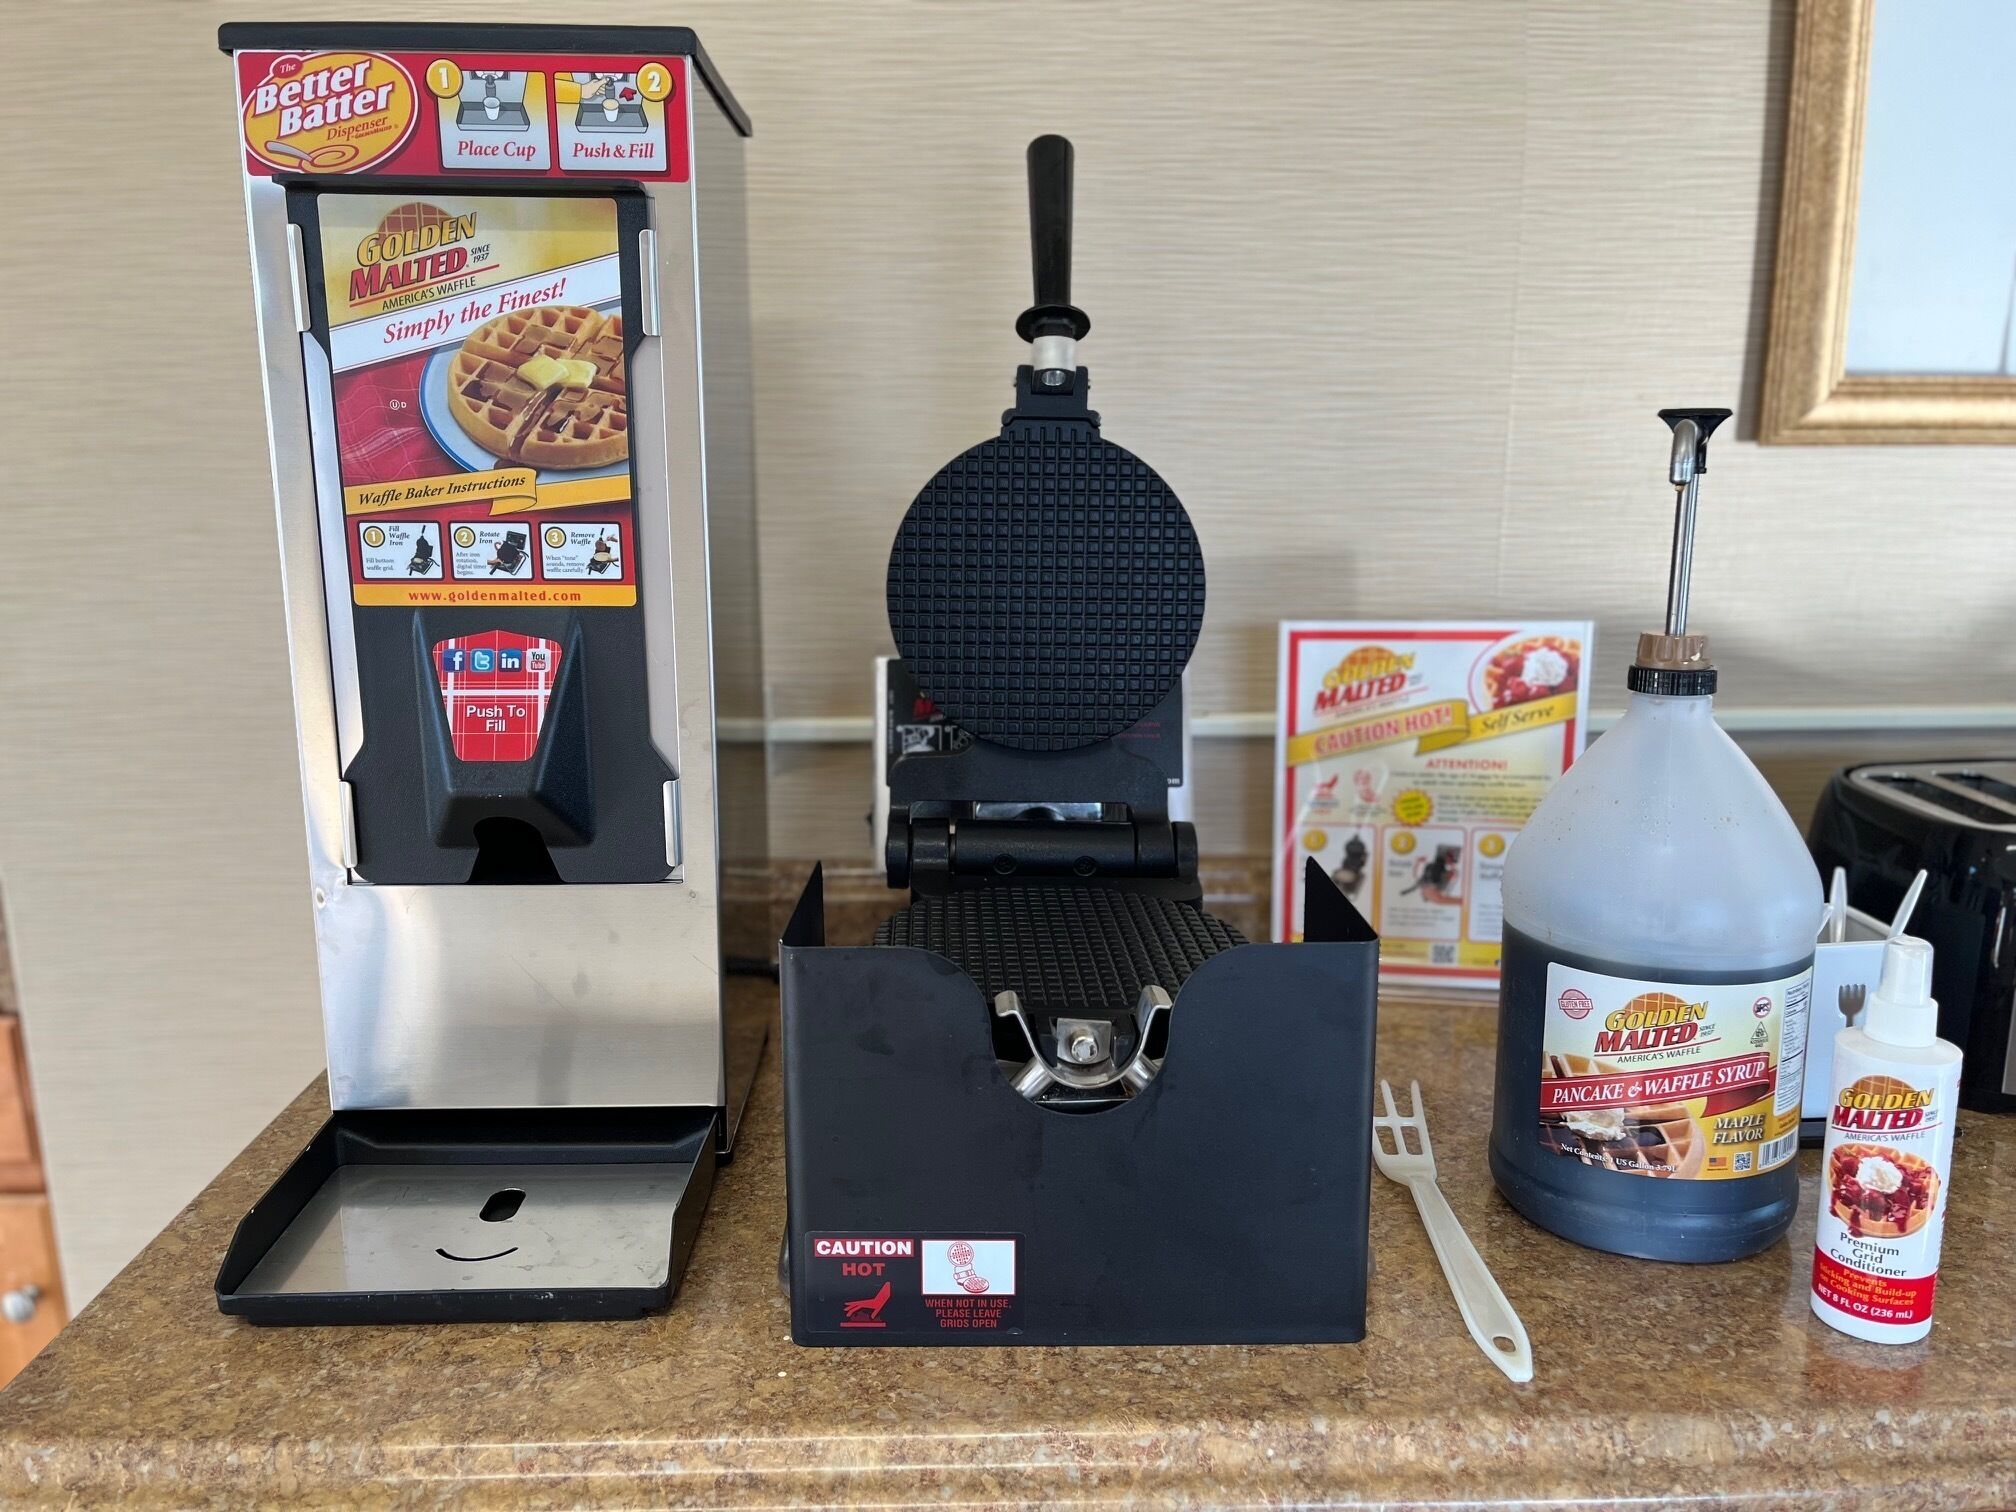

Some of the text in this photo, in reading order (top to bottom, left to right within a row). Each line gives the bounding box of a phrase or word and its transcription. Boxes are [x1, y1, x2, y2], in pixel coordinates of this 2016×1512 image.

[280, 63, 297, 74] The
[438, 67, 449, 88] 1
[255, 59, 371, 116] Better
[648, 71, 661, 92] 2
[278, 83, 393, 138] Batter
[326, 116, 388, 141] Dispenser
[457, 140, 536, 162] Place Cup
[573, 142, 655, 159] Push & Fill
[357, 212, 477, 267] GOLDEN
[470, 244, 491, 256] SINCE
[472, 253, 490, 264] 1937
[350, 246, 468, 301] MALTED
[382, 276, 476, 311] AMERICA'S WAFFLE
[383, 277, 567, 345] Simply the Finest!
[359, 476, 526, 506] Waffle Baker Instructions
[370, 530, 377, 542] 1
[460, 531, 468, 542] 2
[551, 532, 559, 543] 3
[408, 590, 581, 603] www.goldenmalted.com
[452, 651, 463, 670] f
[501, 653, 520, 669] in
[531, 651, 546, 661] You
[531, 660, 547, 670] Tube
[1313, 671, 1407, 711] MALTED
[466, 705, 526, 718] Push To
[1480, 704, 1555, 734] Self Serve
[485, 719, 506, 732] Fill
[1314, 719, 1400, 756] CAUTION
[1403, 704, 1452, 734] HOT!
[1561, 1000, 1592, 1009] GLUTEN FREE
[1605, 1001, 1709, 1032] GOLDEN
[1594, 1022, 1698, 1053] MALTED
[1617, 1046, 1702, 1064] AMERICA'S WAFFLE
[1552, 1061, 1765, 1104] PANCAKE & WAFFLE SYRUP
[1839, 1088, 1935, 1110] GOLDEN
[1713, 1114, 1764, 1130] MAPLE
[1832, 1105, 1923, 1130] MALTED
[1712, 1128, 1763, 1144] FLAVOR
[1844, 1131, 1926, 1142] AMERICA'S WAFFLE
[1561, 1143, 1573, 1153] Net
[1616, 1157, 1628, 1167] US
[1629, 1160, 1655, 1171] Gallon
[816, 1240, 912, 1256] CAUTION
[1840, 1232, 1900, 1256] Premium
[1830, 1248, 1907, 1277] Conditioner
[1852, 1248, 1884, 1264] Grid
[842, 1262, 886, 1277] HOT
[1844, 1268, 1888, 1287] Prevents
[1830, 1279, 1870, 1303] Cooking
[1871, 1294, 1915, 1306] Surfaces
[1852, 1282, 1872, 1292] and
[1875, 1286, 1917, 1299] Build-up
[925, 1299, 953, 1308] WHEN
[956, 1299, 975, 1308] NOT
[977, 1299, 988, 1308] IN
[1818, 1283, 1914, 1320] NET 8 FL OZ (236 mL)
[936, 1309, 1002, 1319] PLEASE LEAVE
[940, 1319, 997, 1328] GRIDS OPEN
